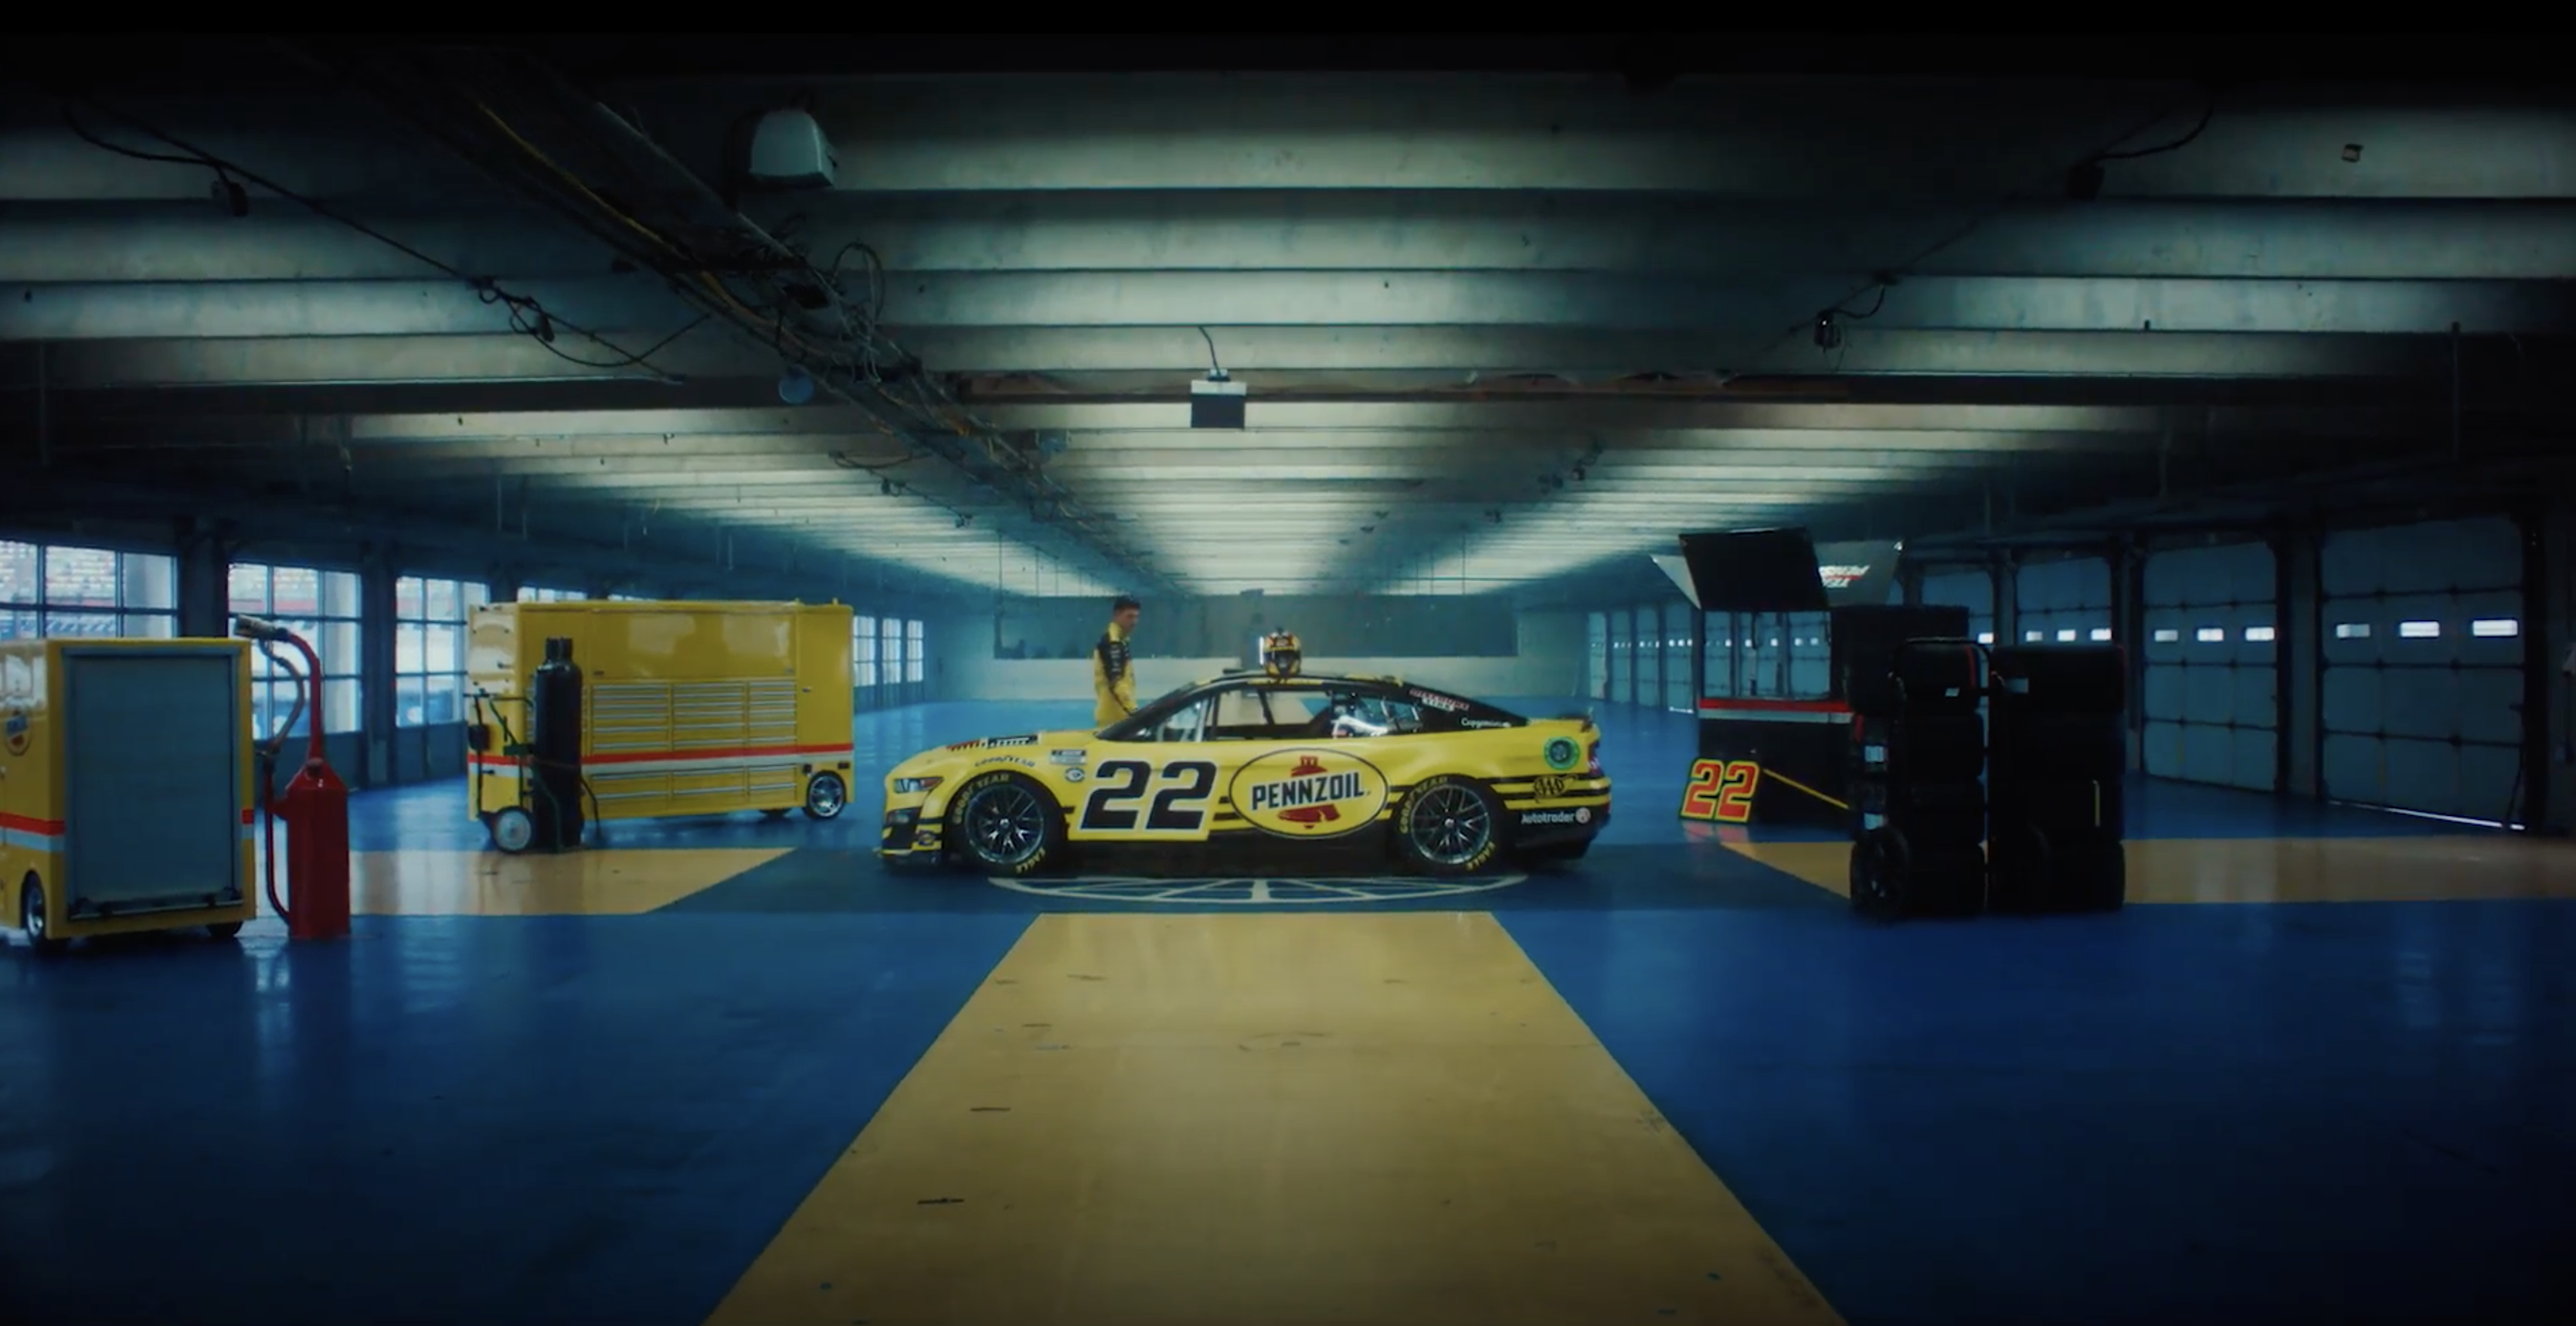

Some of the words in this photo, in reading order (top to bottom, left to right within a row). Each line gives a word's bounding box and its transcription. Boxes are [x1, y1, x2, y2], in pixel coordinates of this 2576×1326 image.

[1079, 760, 1217, 830] 22
[1251, 771, 1364, 811] PENNZOIL
[1681, 758, 1759, 823] 22
[1521, 811, 1575, 824] Autotrader
